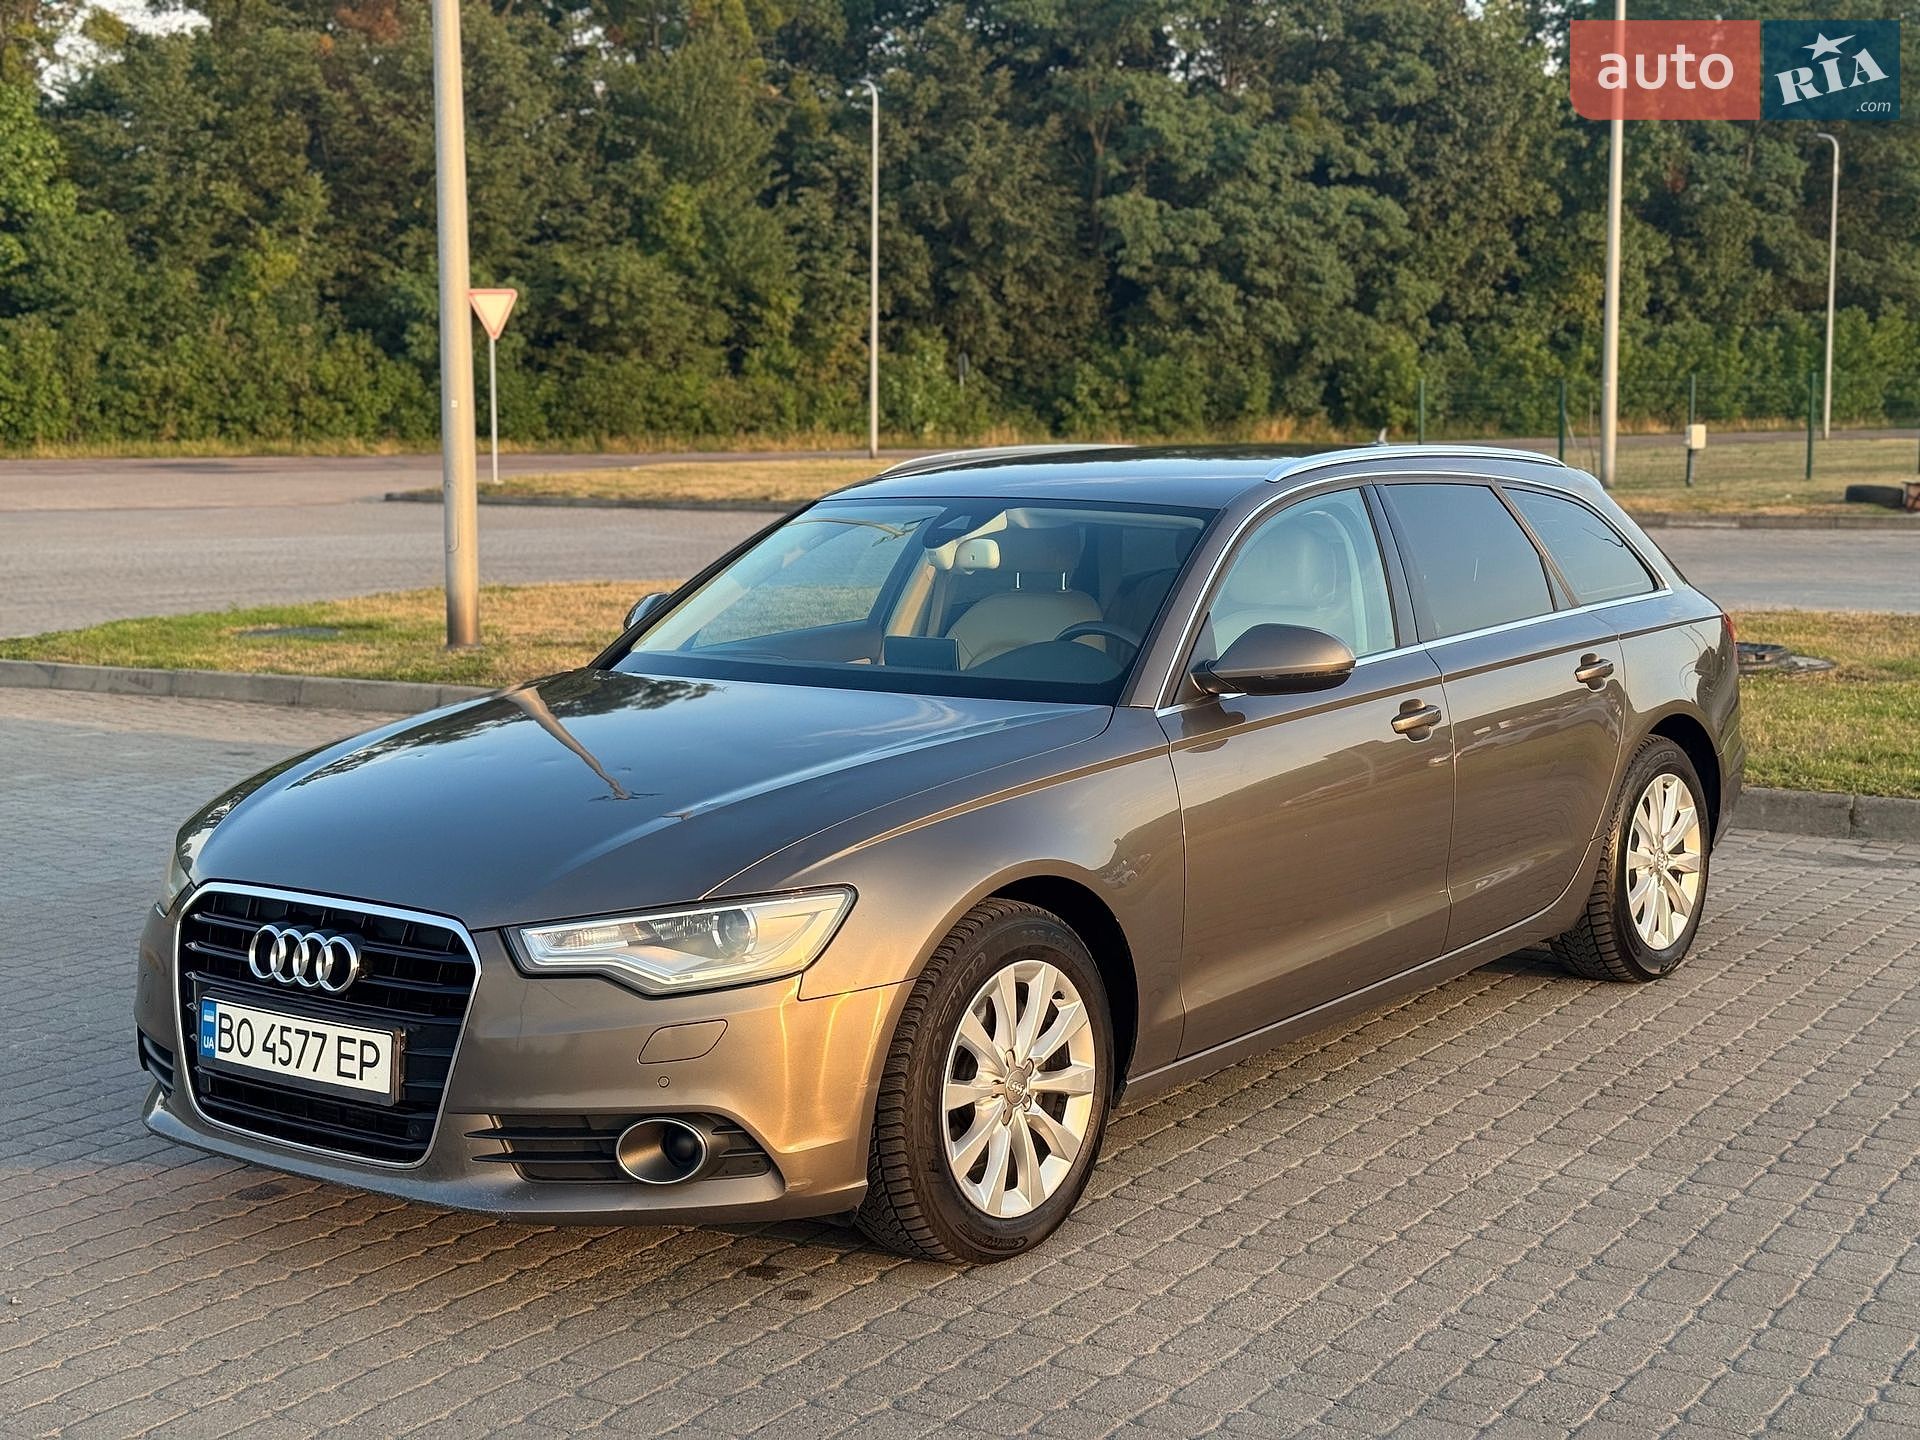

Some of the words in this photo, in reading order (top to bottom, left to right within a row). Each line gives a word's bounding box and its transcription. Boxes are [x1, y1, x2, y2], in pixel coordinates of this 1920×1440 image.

[203, 1035, 215, 1049] UA
[218, 1012, 254, 1058] BO
[262, 1023, 327, 1072] 4577
[337, 1035, 380, 1080] EP
